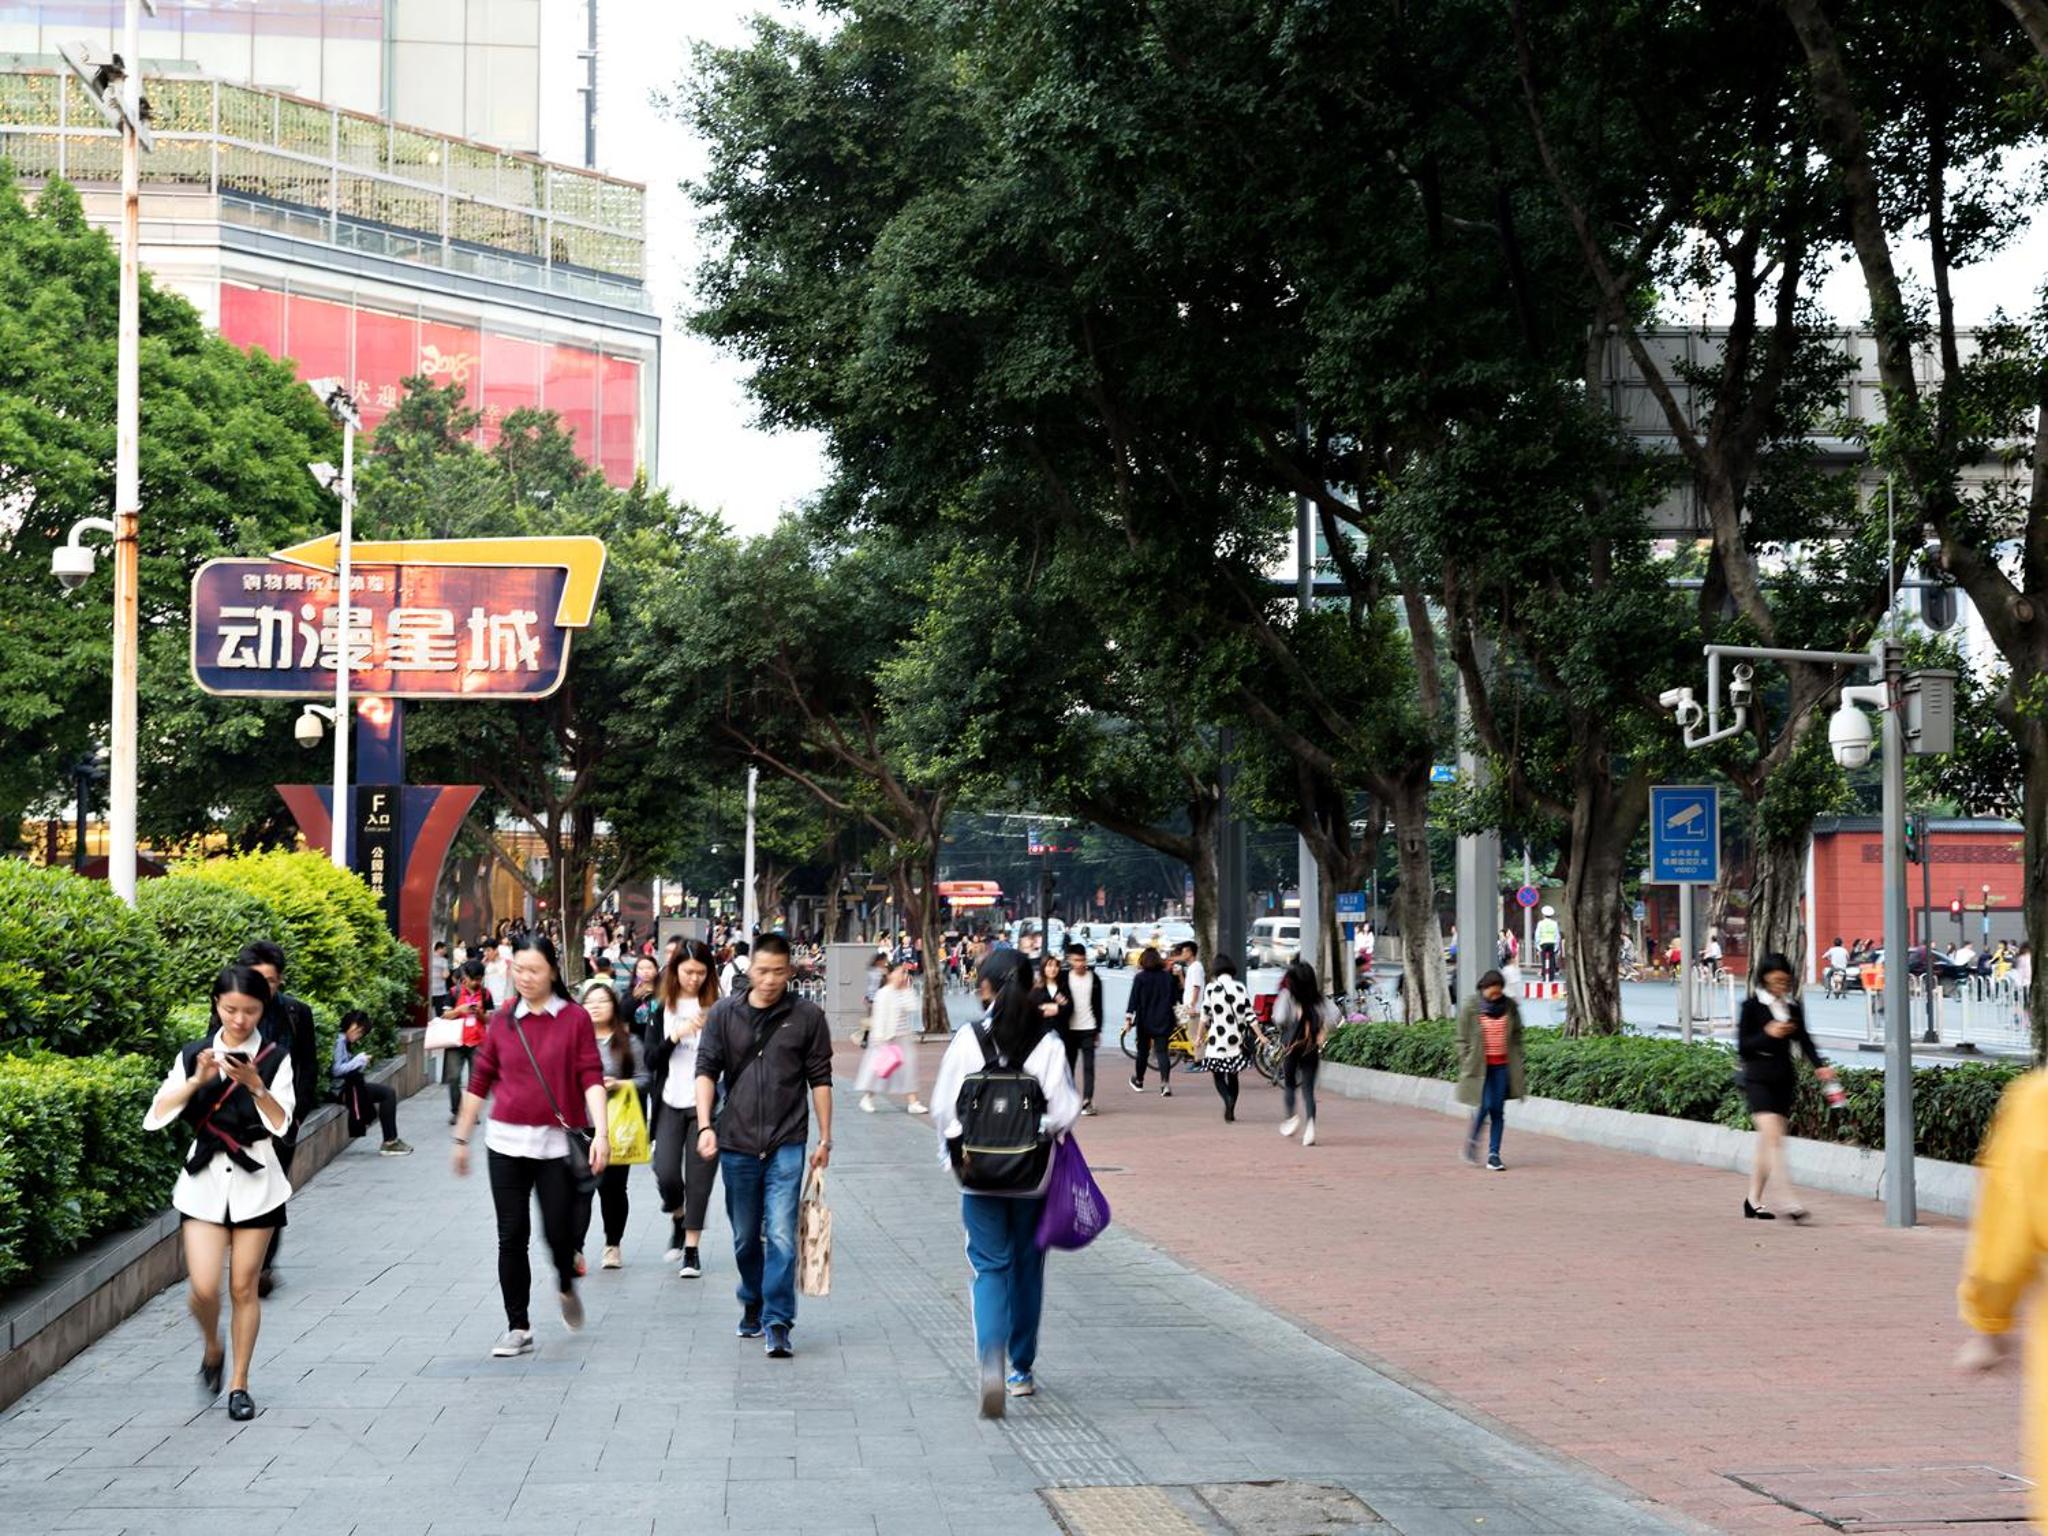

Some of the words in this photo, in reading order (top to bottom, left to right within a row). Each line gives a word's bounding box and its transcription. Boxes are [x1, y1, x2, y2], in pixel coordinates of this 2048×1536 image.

[217, 603, 540, 671] 动漫星城
[373, 794, 386, 812] F
[367, 814, 391, 825] 入口
